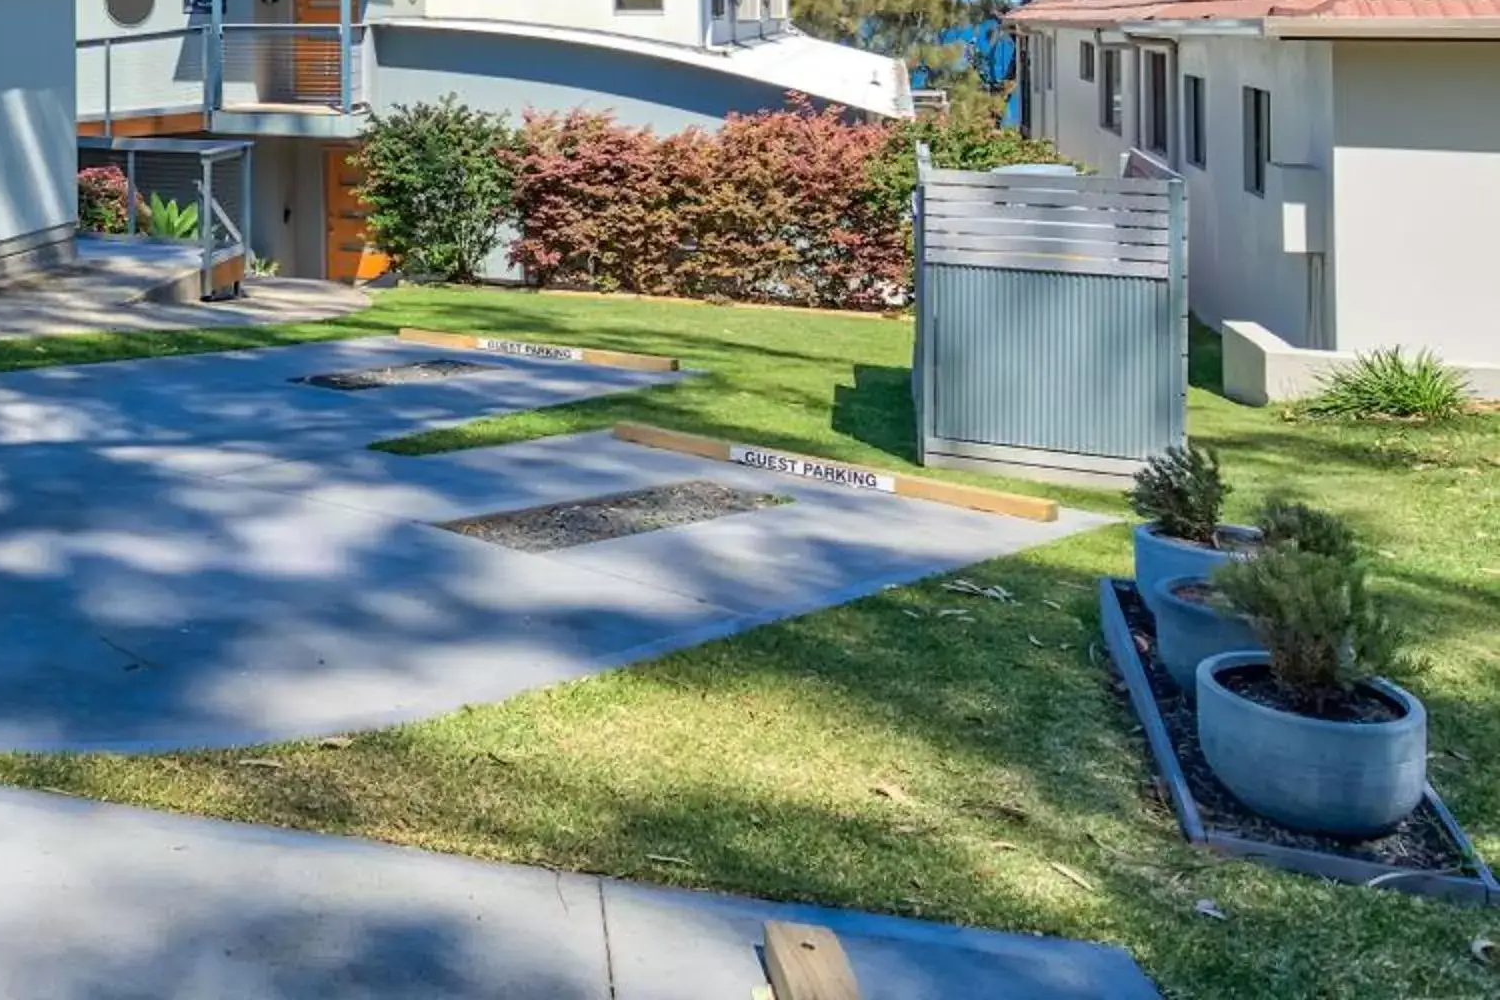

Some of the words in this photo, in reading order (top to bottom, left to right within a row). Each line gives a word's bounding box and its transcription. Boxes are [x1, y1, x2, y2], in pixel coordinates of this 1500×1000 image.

[487, 340, 521, 354] GUEST
[525, 345, 572, 360] PARKING
[744, 450, 797, 472] GUEST
[802, 463, 877, 487] PARKING
